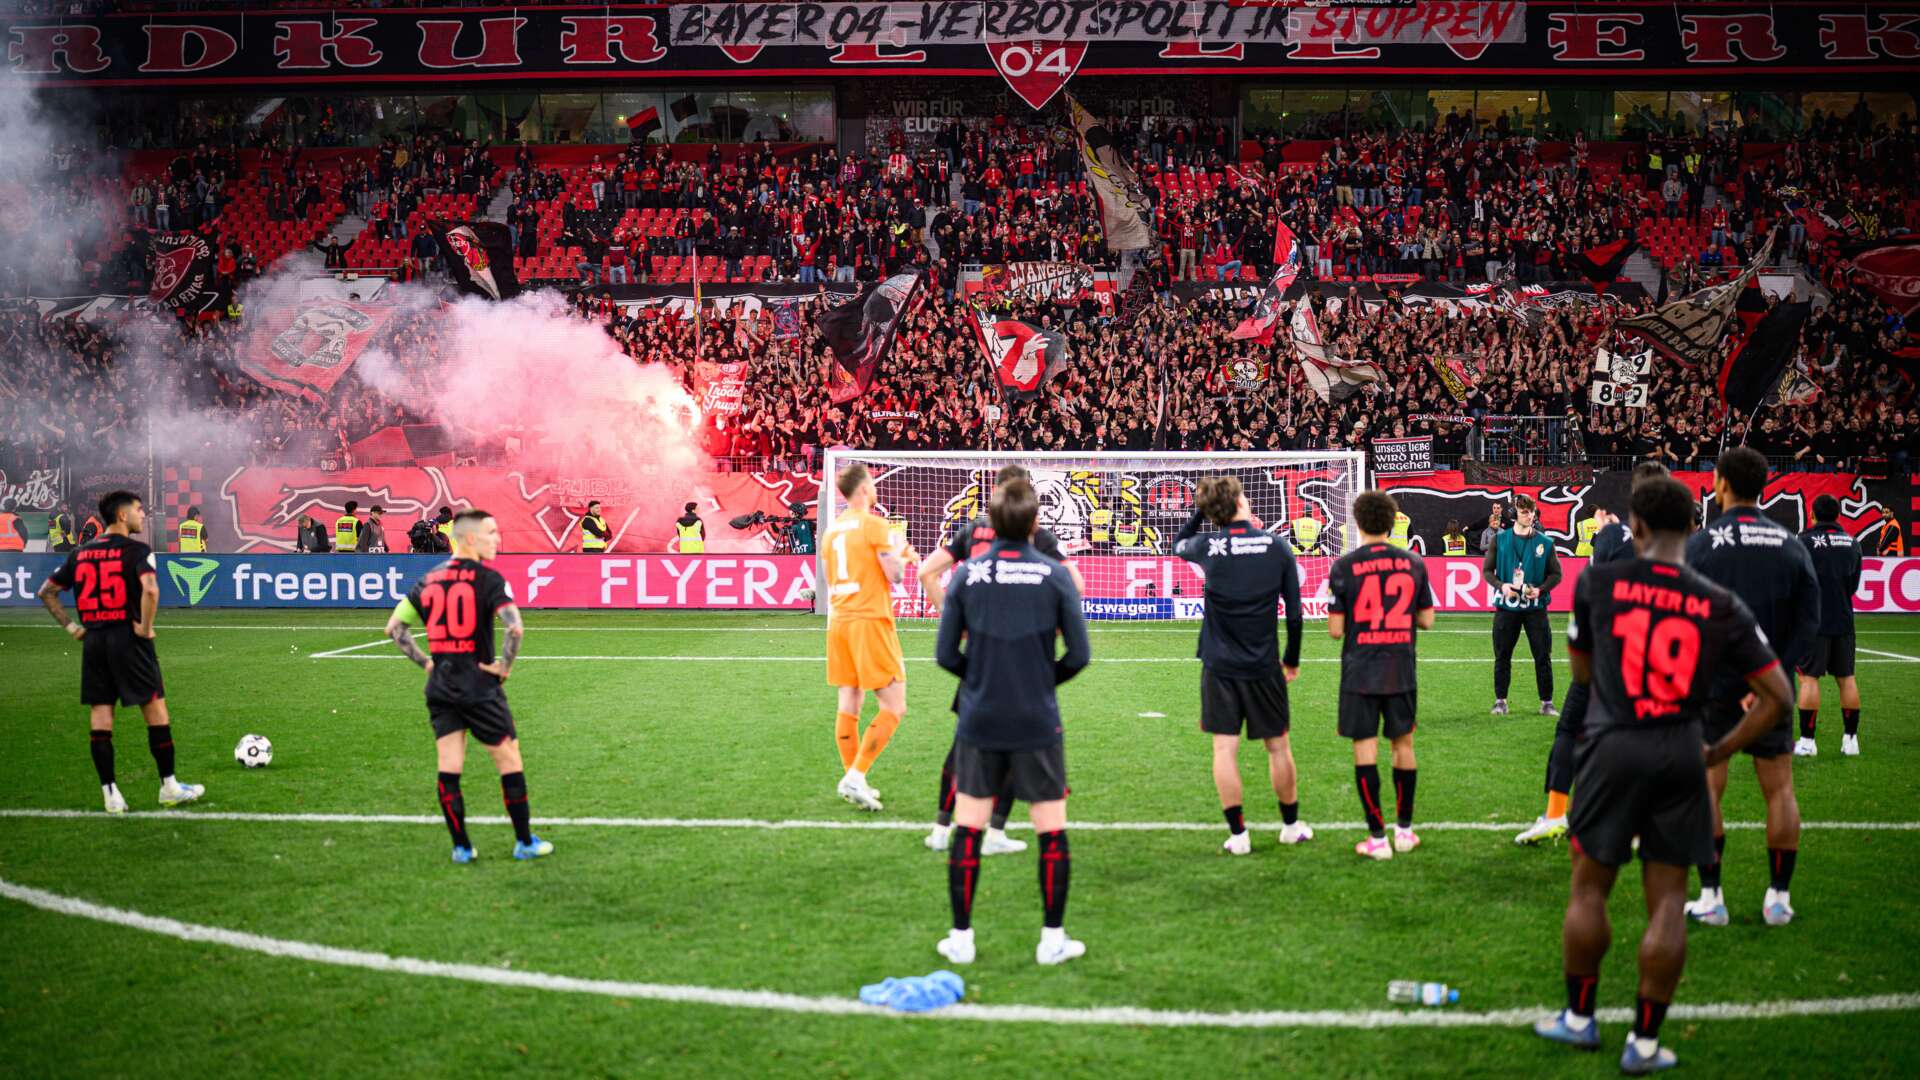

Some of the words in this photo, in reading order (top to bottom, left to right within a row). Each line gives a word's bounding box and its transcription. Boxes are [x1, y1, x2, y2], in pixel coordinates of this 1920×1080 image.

[674, 4, 826, 46] BAYER
[1308, 2, 1515, 42] STOPPEN
[1001, 47, 1072, 77] 04
[893, 100, 929, 116] WIR
[930, 95, 965, 116] FÜR
[1140, 95, 1175, 115] FÜR
[904, 117, 943, 133] EUC
[1410, 452, 1431, 461] NIE
[832, 532, 849, 580] 1
[75, 560, 127, 611] 25
[232, 563, 407, 601] freenet
[1353, 572, 1415, 630] 42
[1613, 579, 1683, 612] BAYER
[1684, 595, 1711, 620] 04
[420, 582, 477, 639] 20
[1080, 600, 1157, 616] lkswagen
[1612, 606, 1702, 704] 19
